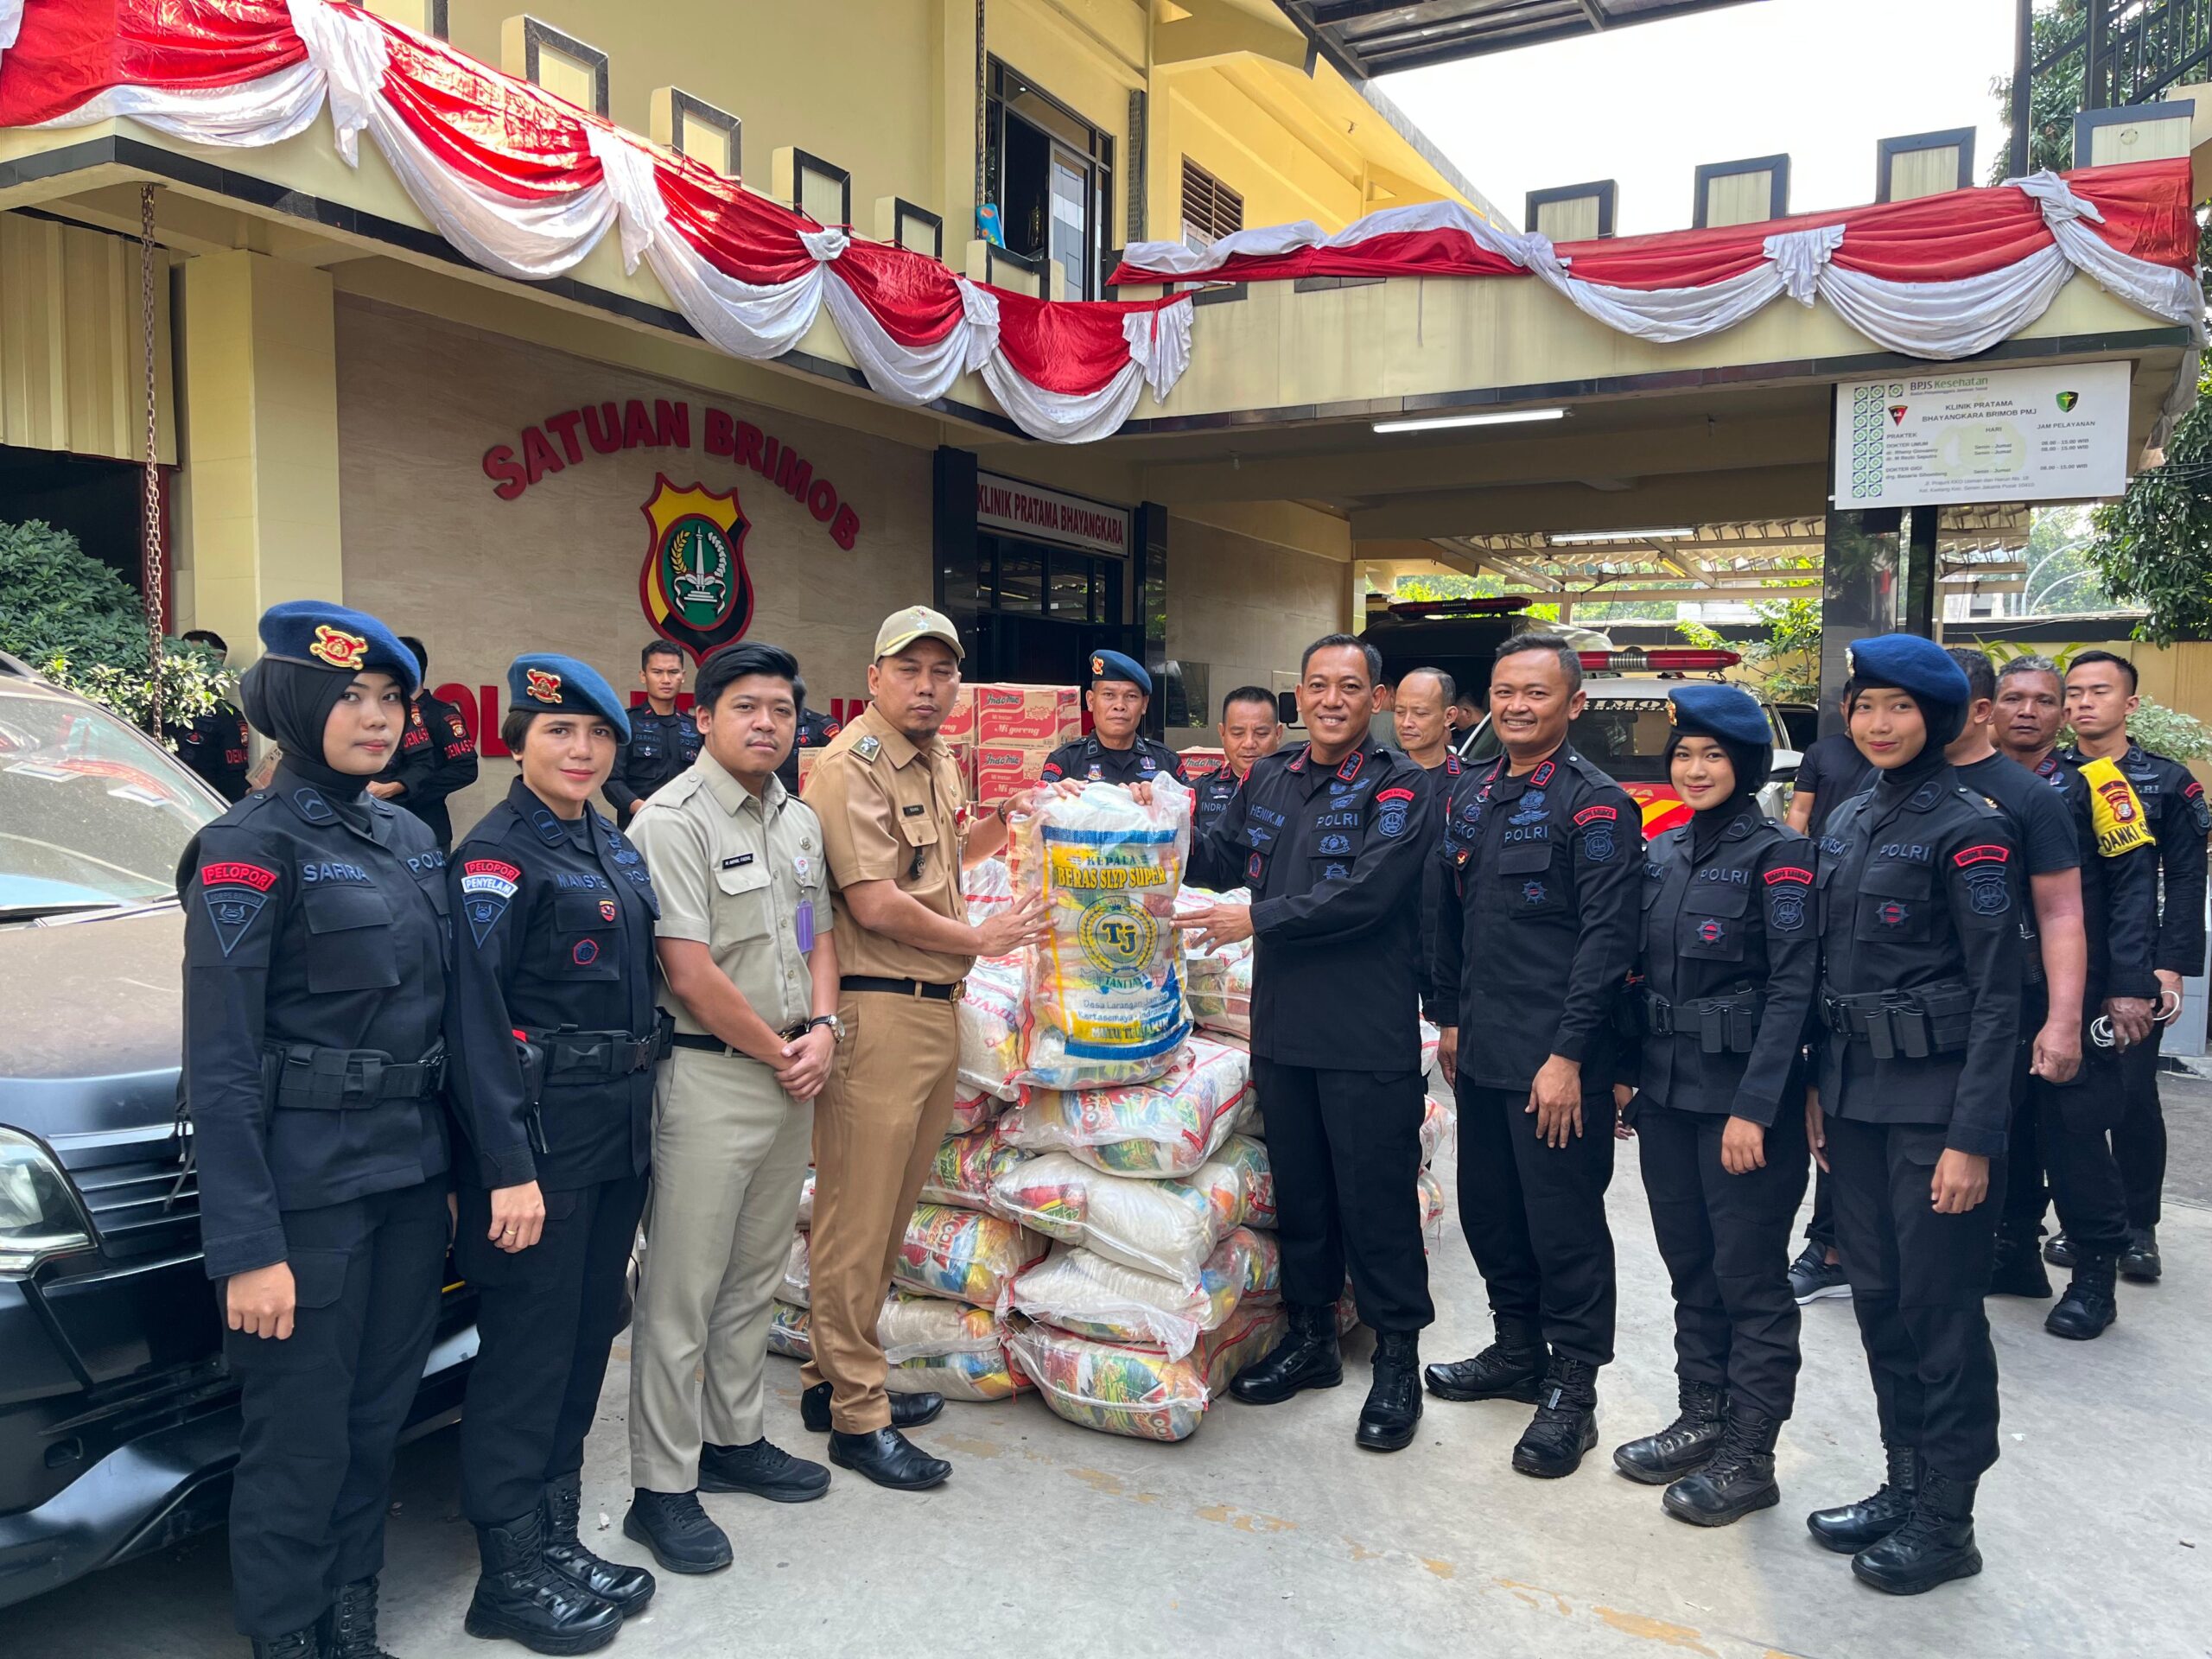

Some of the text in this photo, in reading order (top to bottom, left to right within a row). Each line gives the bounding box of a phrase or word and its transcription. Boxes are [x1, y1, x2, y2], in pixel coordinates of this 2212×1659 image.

[1910, 377, 1988, 391] BPJS Kesehatan
[1974, 400, 2013, 409] PRATAMA
[1922, 411, 1984, 422] BHAYANGKARA
[1986, 410, 2018, 418] BRIMOB
[482, 399, 861, 551] SATUAN BRIMOB
[977, 484, 1123, 544] KLINIK PRATAMA BHAYANGKARA
[1009, 727, 1039, 735] goreng
[1315, 813, 1358, 830] POLRI
[1504, 825, 1548, 843] POLRI
[2101, 824, 2141, 852] DANKI
[1087, 855, 1136, 866] KEPALA
[1879, 843, 1932, 862] POLRI
[207, 866, 269, 887] PELOPOR
[469, 862, 515, 879] PELOPOR
[1057, 865, 1166, 890] BERAS SLYP SUPER
[1699, 868, 1750, 885] POLRI
[467, 877, 512, 894] PENYELAM
[1084, 999, 1105, 1009] Desa
[1107, 999, 1143, 1010] Larangan
